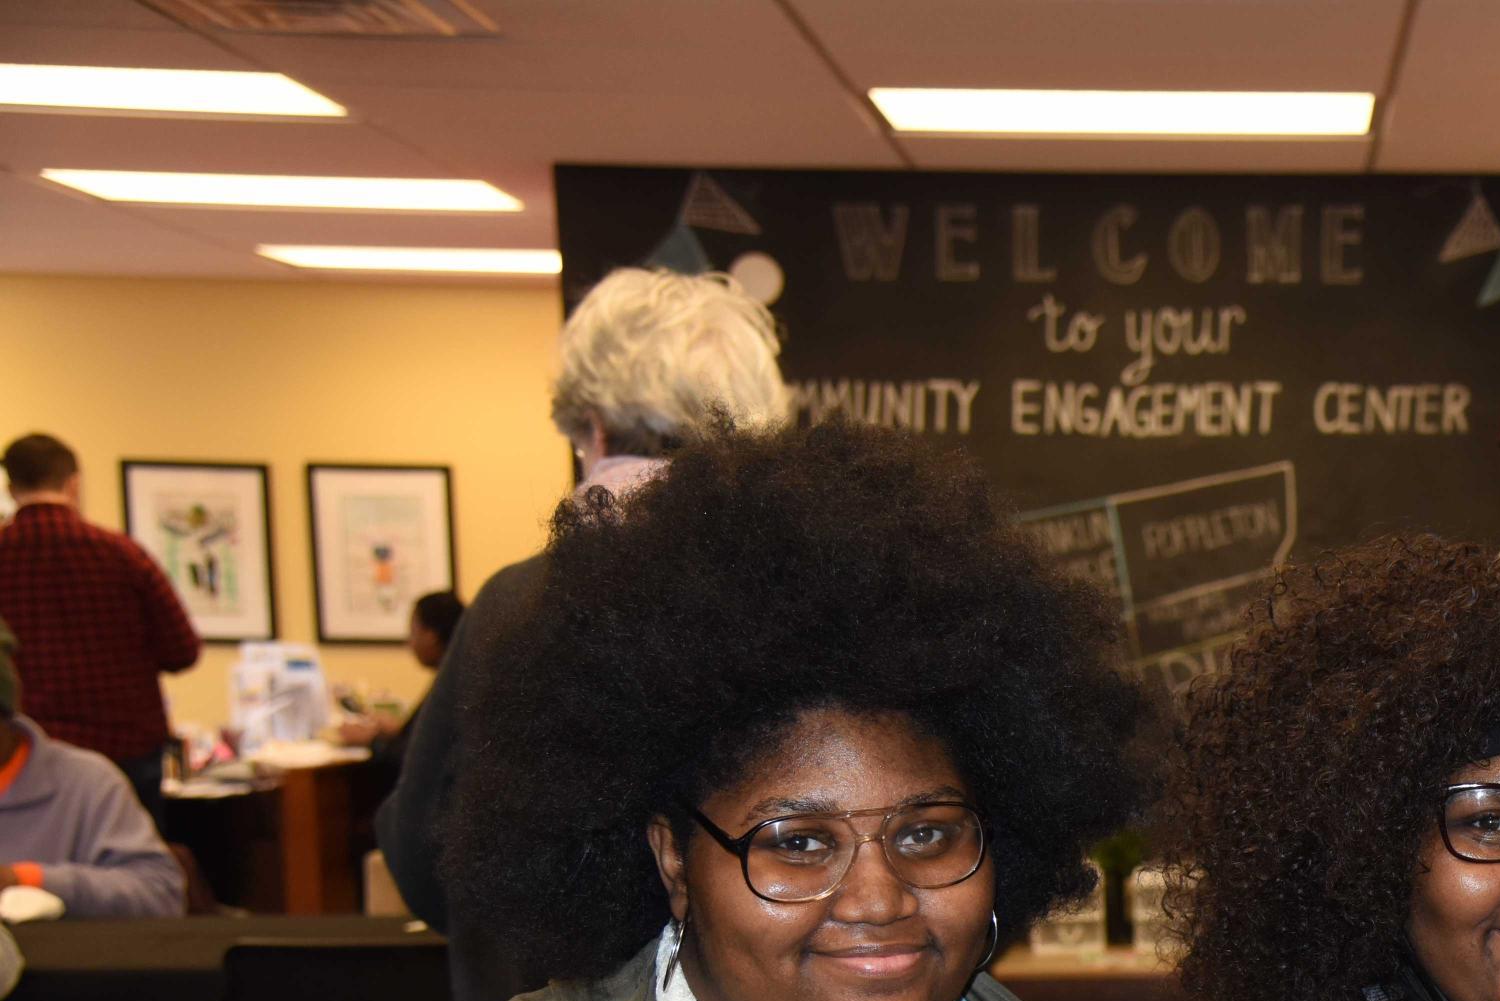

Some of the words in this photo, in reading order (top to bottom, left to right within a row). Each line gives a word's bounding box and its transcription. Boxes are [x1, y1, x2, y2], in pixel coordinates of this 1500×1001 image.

[832, 203, 1366, 286] WELCOME
[1027, 293, 1104, 353] to
[1120, 305, 1247, 387] your
[786, 376, 981, 434] MMUNITY
[1010, 378, 1283, 439] ENGAGEMENT
[1313, 381, 1471, 435] CENTER
